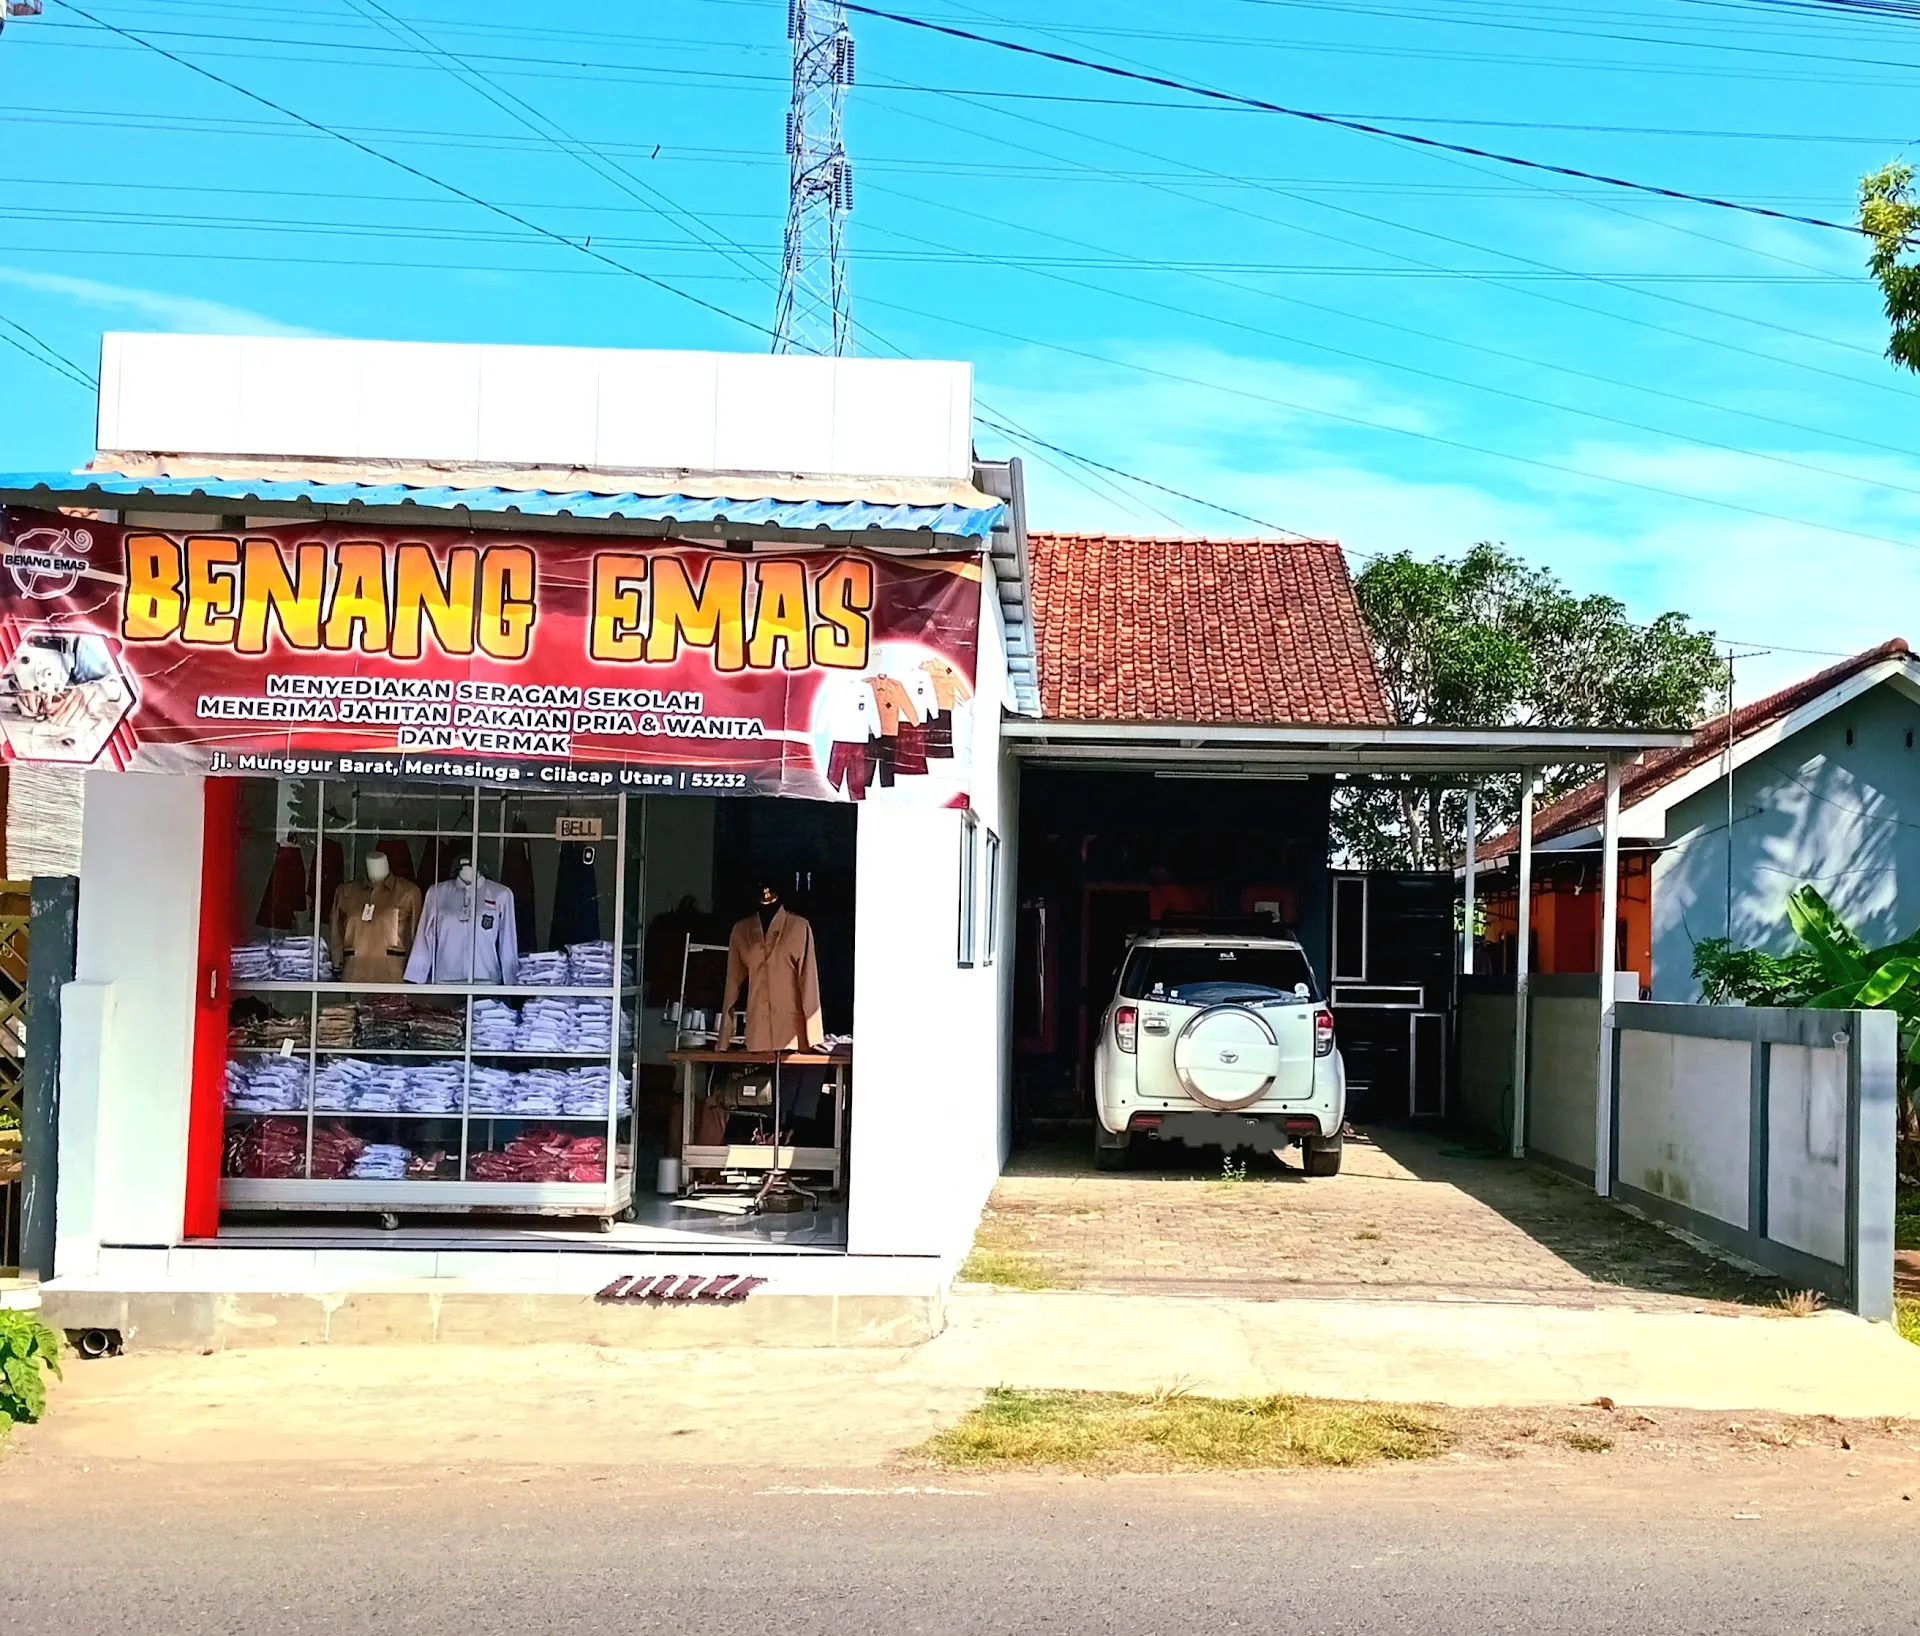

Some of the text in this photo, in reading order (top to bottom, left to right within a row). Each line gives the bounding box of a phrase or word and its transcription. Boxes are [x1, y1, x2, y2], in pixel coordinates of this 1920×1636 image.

[4, 554, 87, 571] BENANG EMAS
[121, 533, 874, 672] BENANG EMAS
[269, 677, 700, 710] MENYEDIAKAN SERAGAM SEKOLAH
[200, 698, 764, 736] MENERIMA JAHITAN PAKAIAN PRIA & WANITA
[400, 729, 568, 753] DAN VERMAK
[210, 752, 233, 771] jl.
[238, 754, 334, 774] Munggur
[339, 758, 399, 776] Barat,
[404, 760, 521, 782] Mertasinga
[540, 765, 613, 787] Cilacap
[619, 769, 674, 786] Utara
[690, 773, 747, 789] 53232
[561, 819, 597, 837] BELL
